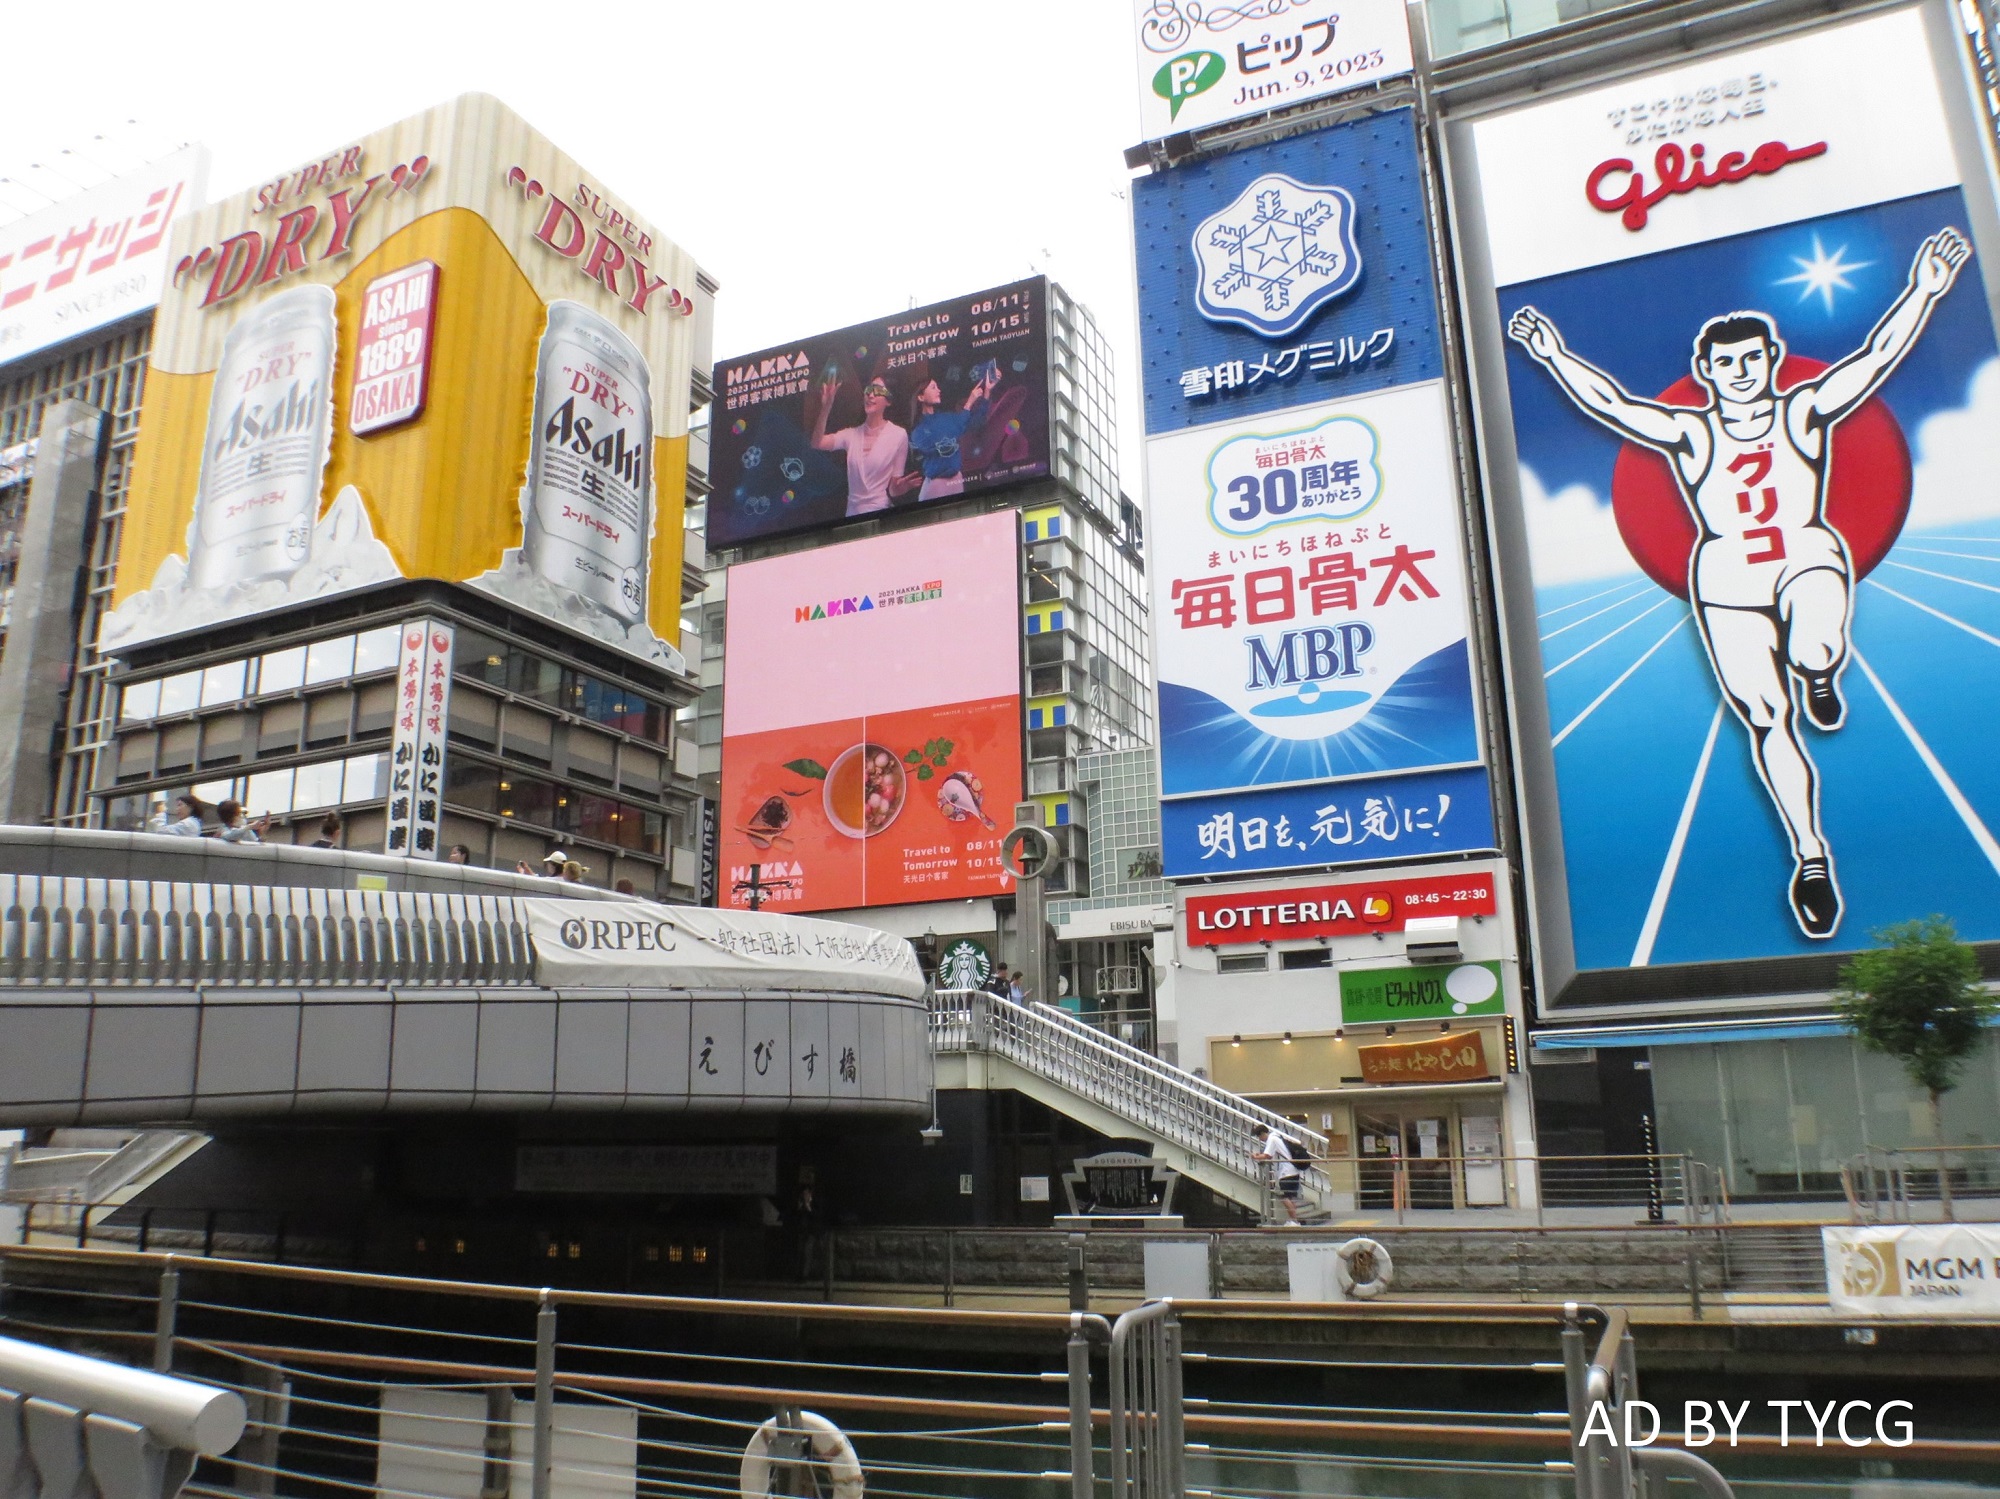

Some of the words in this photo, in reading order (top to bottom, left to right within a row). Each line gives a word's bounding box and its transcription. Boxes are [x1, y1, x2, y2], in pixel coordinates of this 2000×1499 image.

[1237, 14, 1340, 75] ピップ
[1234, 81, 1289, 105] Jun.
[1321, 49, 1384, 82] 2023
[253, 145, 361, 216] SUPER
[575, 183, 652, 257] SUPER
[364, 273, 428, 329] ASAHI
[971, 293, 1019, 316] 08/11
[887, 316, 932, 337] Travel
[936, 313, 950, 325] to
[887, 327, 960, 353] Tomorrow
[971, 314, 1020, 337] 10/15
[971, 337, 998, 348] TAIWAN
[1000, 328, 1030, 341] TAOYUAN
[359, 327, 422, 381] 1889
[727, 350, 810, 386] HAKKA
[1179, 328, 1394, 397] 雪印メグミルク
[584, 362, 618, 390] SUPER
[727, 384, 748, 397] 2023
[751, 376, 782, 390] HAKKA
[785, 368, 810, 381] EXPO
[352, 371, 416, 425] OSAKA
[215, 378, 318, 463] Asahi
[545, 396, 641, 490] Asahi
[1255, 435, 1325, 454] まいにちほねぶと
[1255, 444, 1326, 469] 毎日骨太
[247, 452, 273, 477] 生
[581, 469, 605, 501] 生
[1302, 486, 1361, 507] ありがとう
[1726, 442, 1786, 565] グリコ
[563, 505, 620, 543] スーパードライ
[1208, 523, 1392, 568] まいにちほねぶと
[879, 590, 894, 598] 2023
[1171, 544, 1441, 629] 毎日骨太
[795, 595, 874, 623] HAKKA
[1246, 622, 1374, 689] MBP
[401, 656, 419, 731] 本場の味
[427, 659, 445, 734] 本場の味
[702, 808, 714, 898] TSUTAYA
[903, 846, 937, 858] Travel
[940, 845, 951, 854] to
[966, 839, 1002, 851] 08/11
[903, 858, 958, 871] Tomorrow
[966, 856, 1002, 868] 10/15
[1110, 920, 1138, 930] EBISU
[1140, 919, 1153, 928] BA
[1198, 899, 1355, 931] LOTTERIA
[560, 916, 677, 952] ORPEC
[1385, 979, 1443, 1007] ピタットハウス
[698, 1036, 857, 1085] えびす橋
[1905, 1257, 1985, 1280] MGM
[1909, 1284, 1962, 1297] JAPAN
